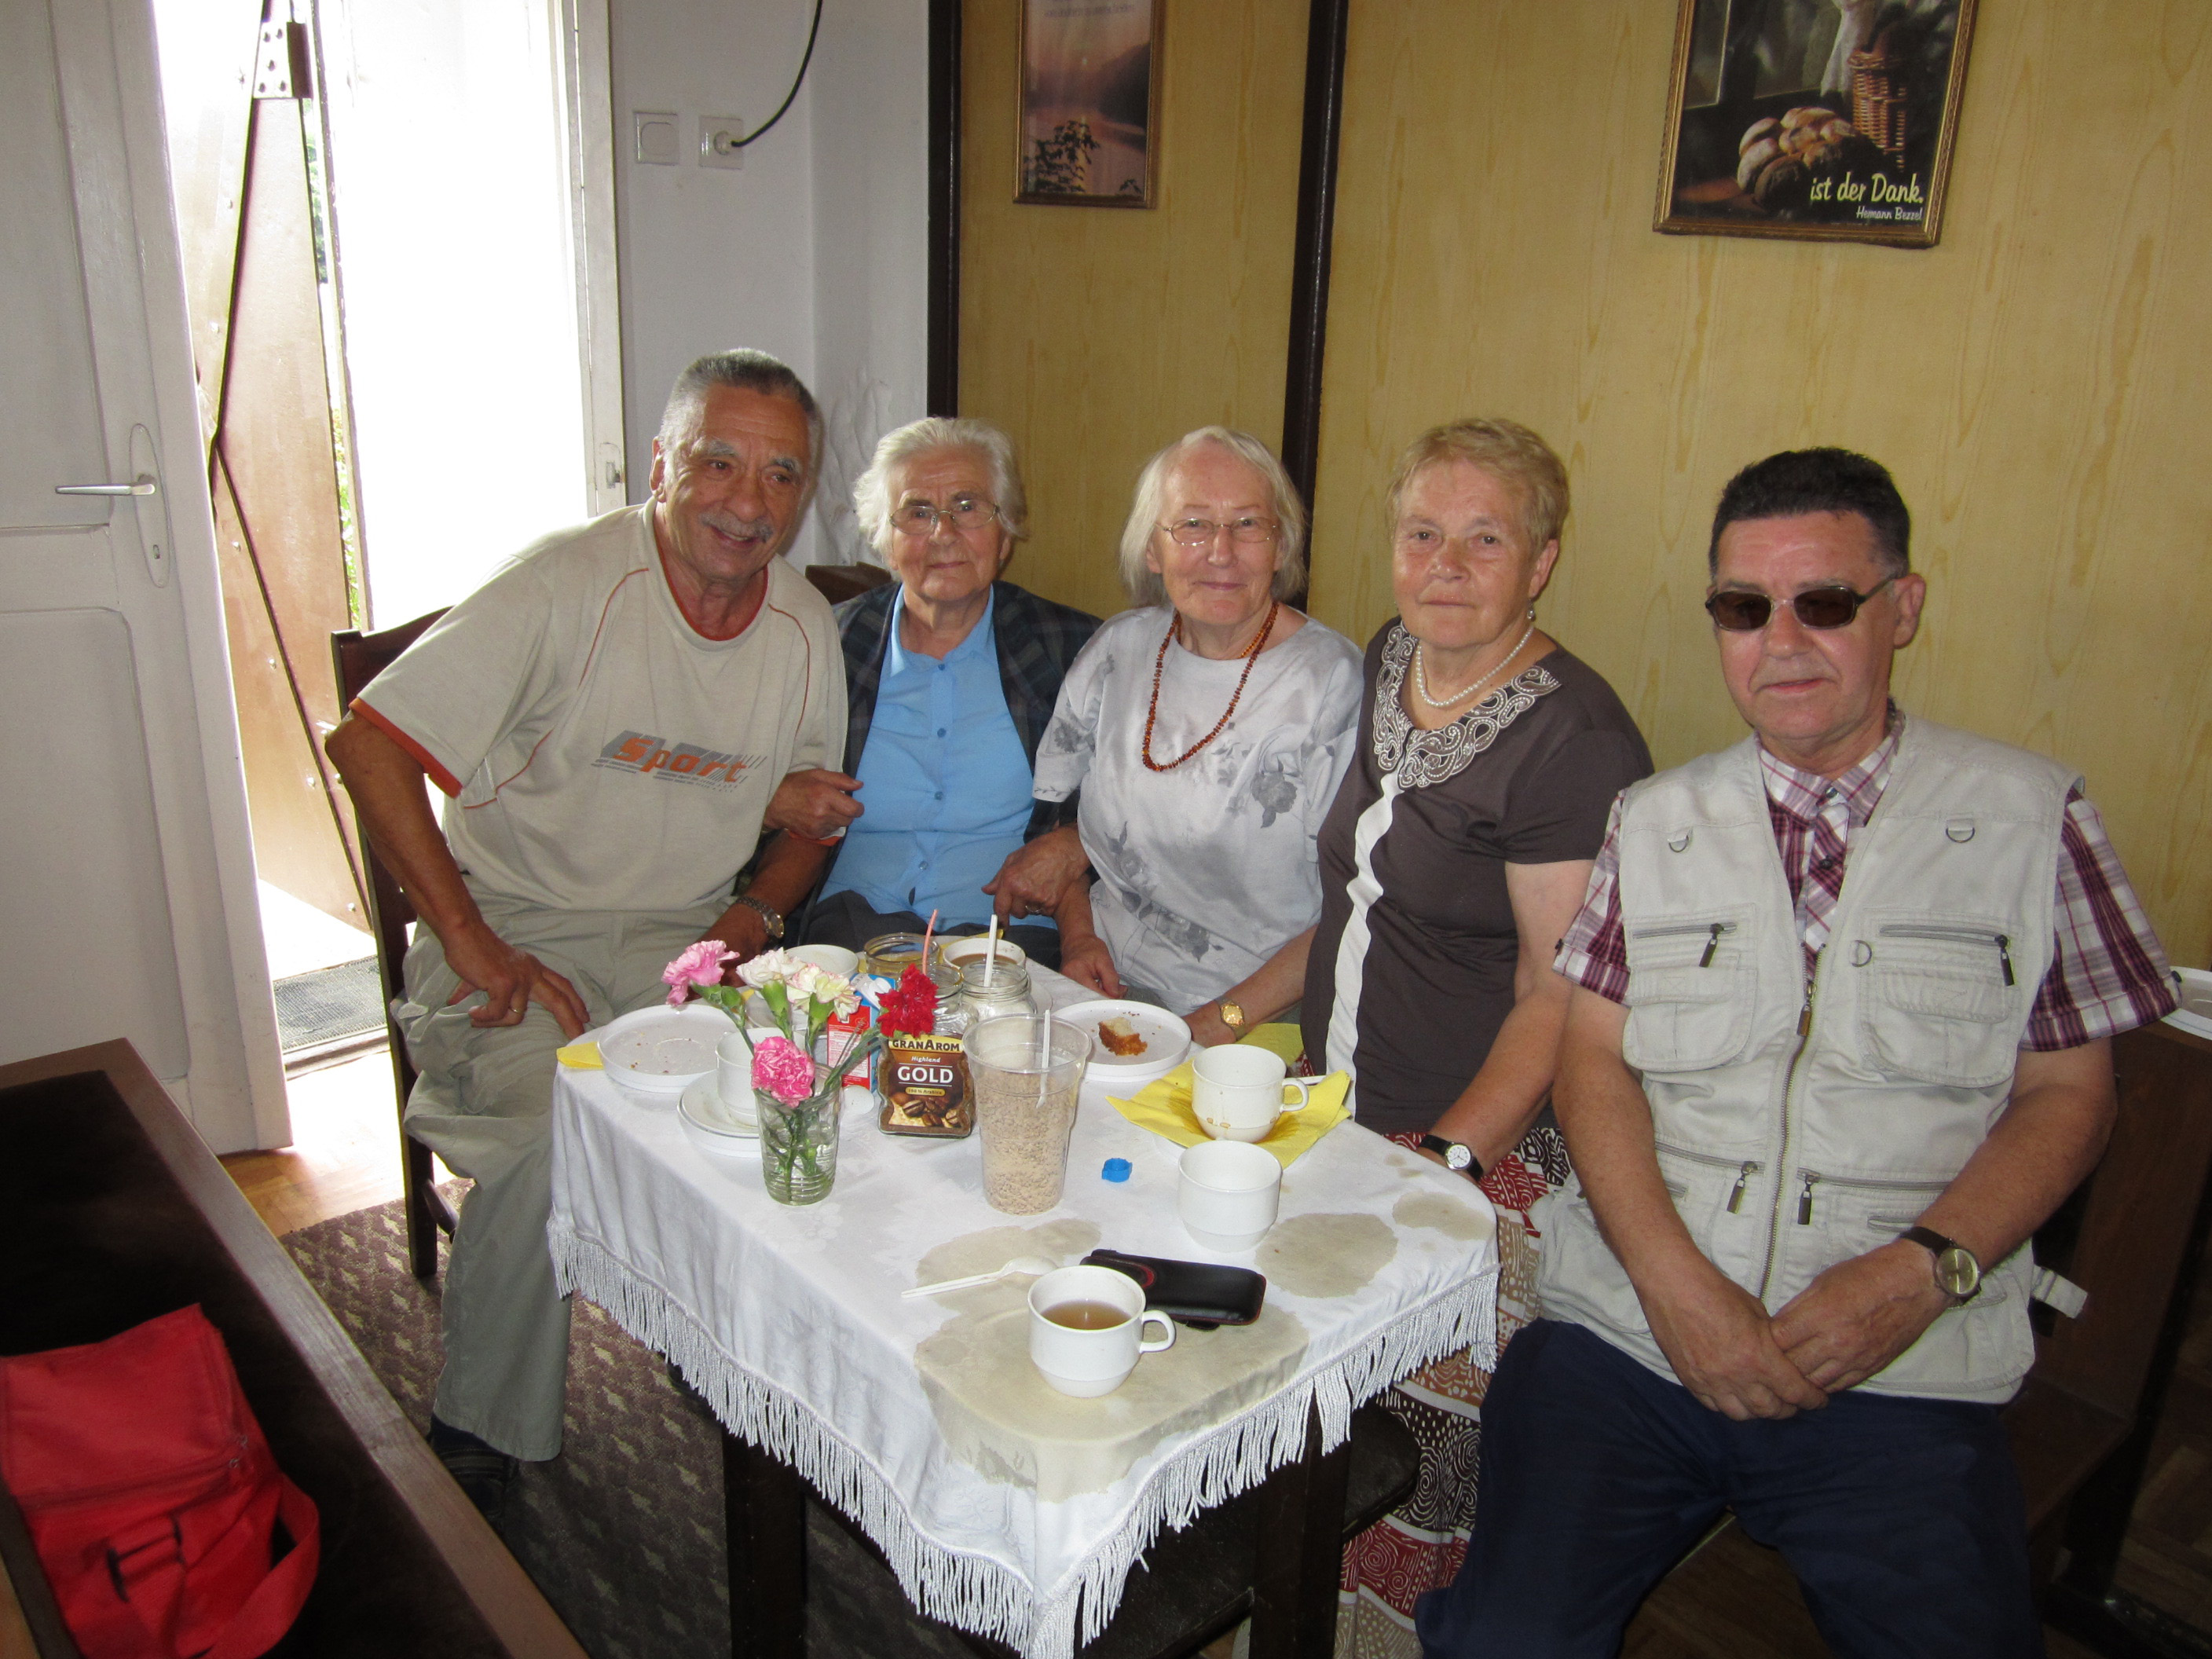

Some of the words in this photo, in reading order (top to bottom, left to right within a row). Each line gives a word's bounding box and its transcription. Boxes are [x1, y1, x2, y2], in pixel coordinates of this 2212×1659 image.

[1809, 177, 1832, 201] ist
[1837, 171, 1866, 202] der
[1870, 172, 1925, 203] Dank.
[613, 737, 747, 783] Sport
[892, 1038, 960, 1052] GRANAROM
[897, 1065, 954, 1084] GOLD
